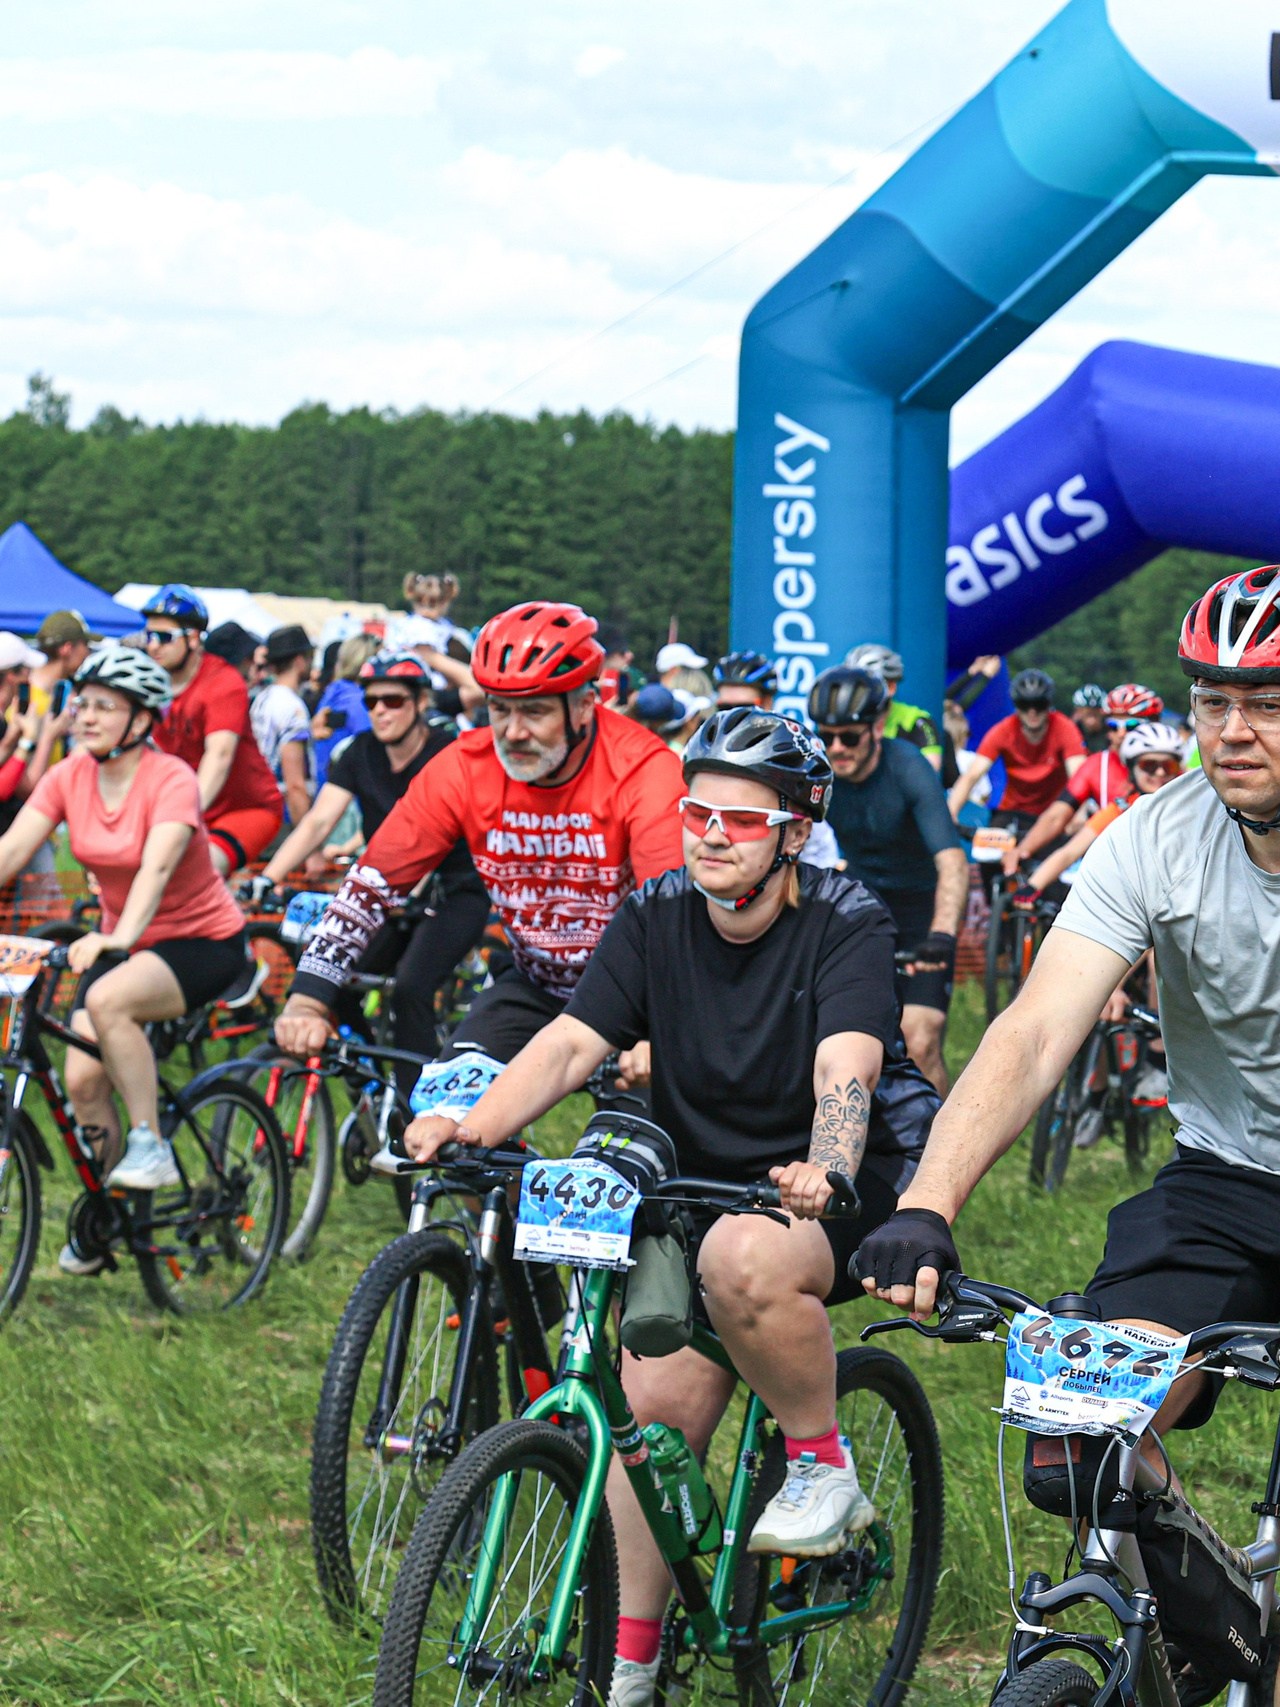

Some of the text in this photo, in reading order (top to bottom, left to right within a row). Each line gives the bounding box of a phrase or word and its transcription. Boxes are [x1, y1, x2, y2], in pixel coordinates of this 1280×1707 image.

[762, 412, 831, 733] aspersky
[529, 1167, 634, 1211] 4430
[1021, 1316, 1169, 1378] 4692
[1059, 1366, 1112, 1386] СЕРГЕЙ
[1063, 1380, 1102, 1394] ПОБЫЛЕЦ
[1044, 1407, 1069, 1416] ARMYTEK
[678, 1483, 697, 1536] SPORTS
[1228, 1625, 1262, 1667] Racer
